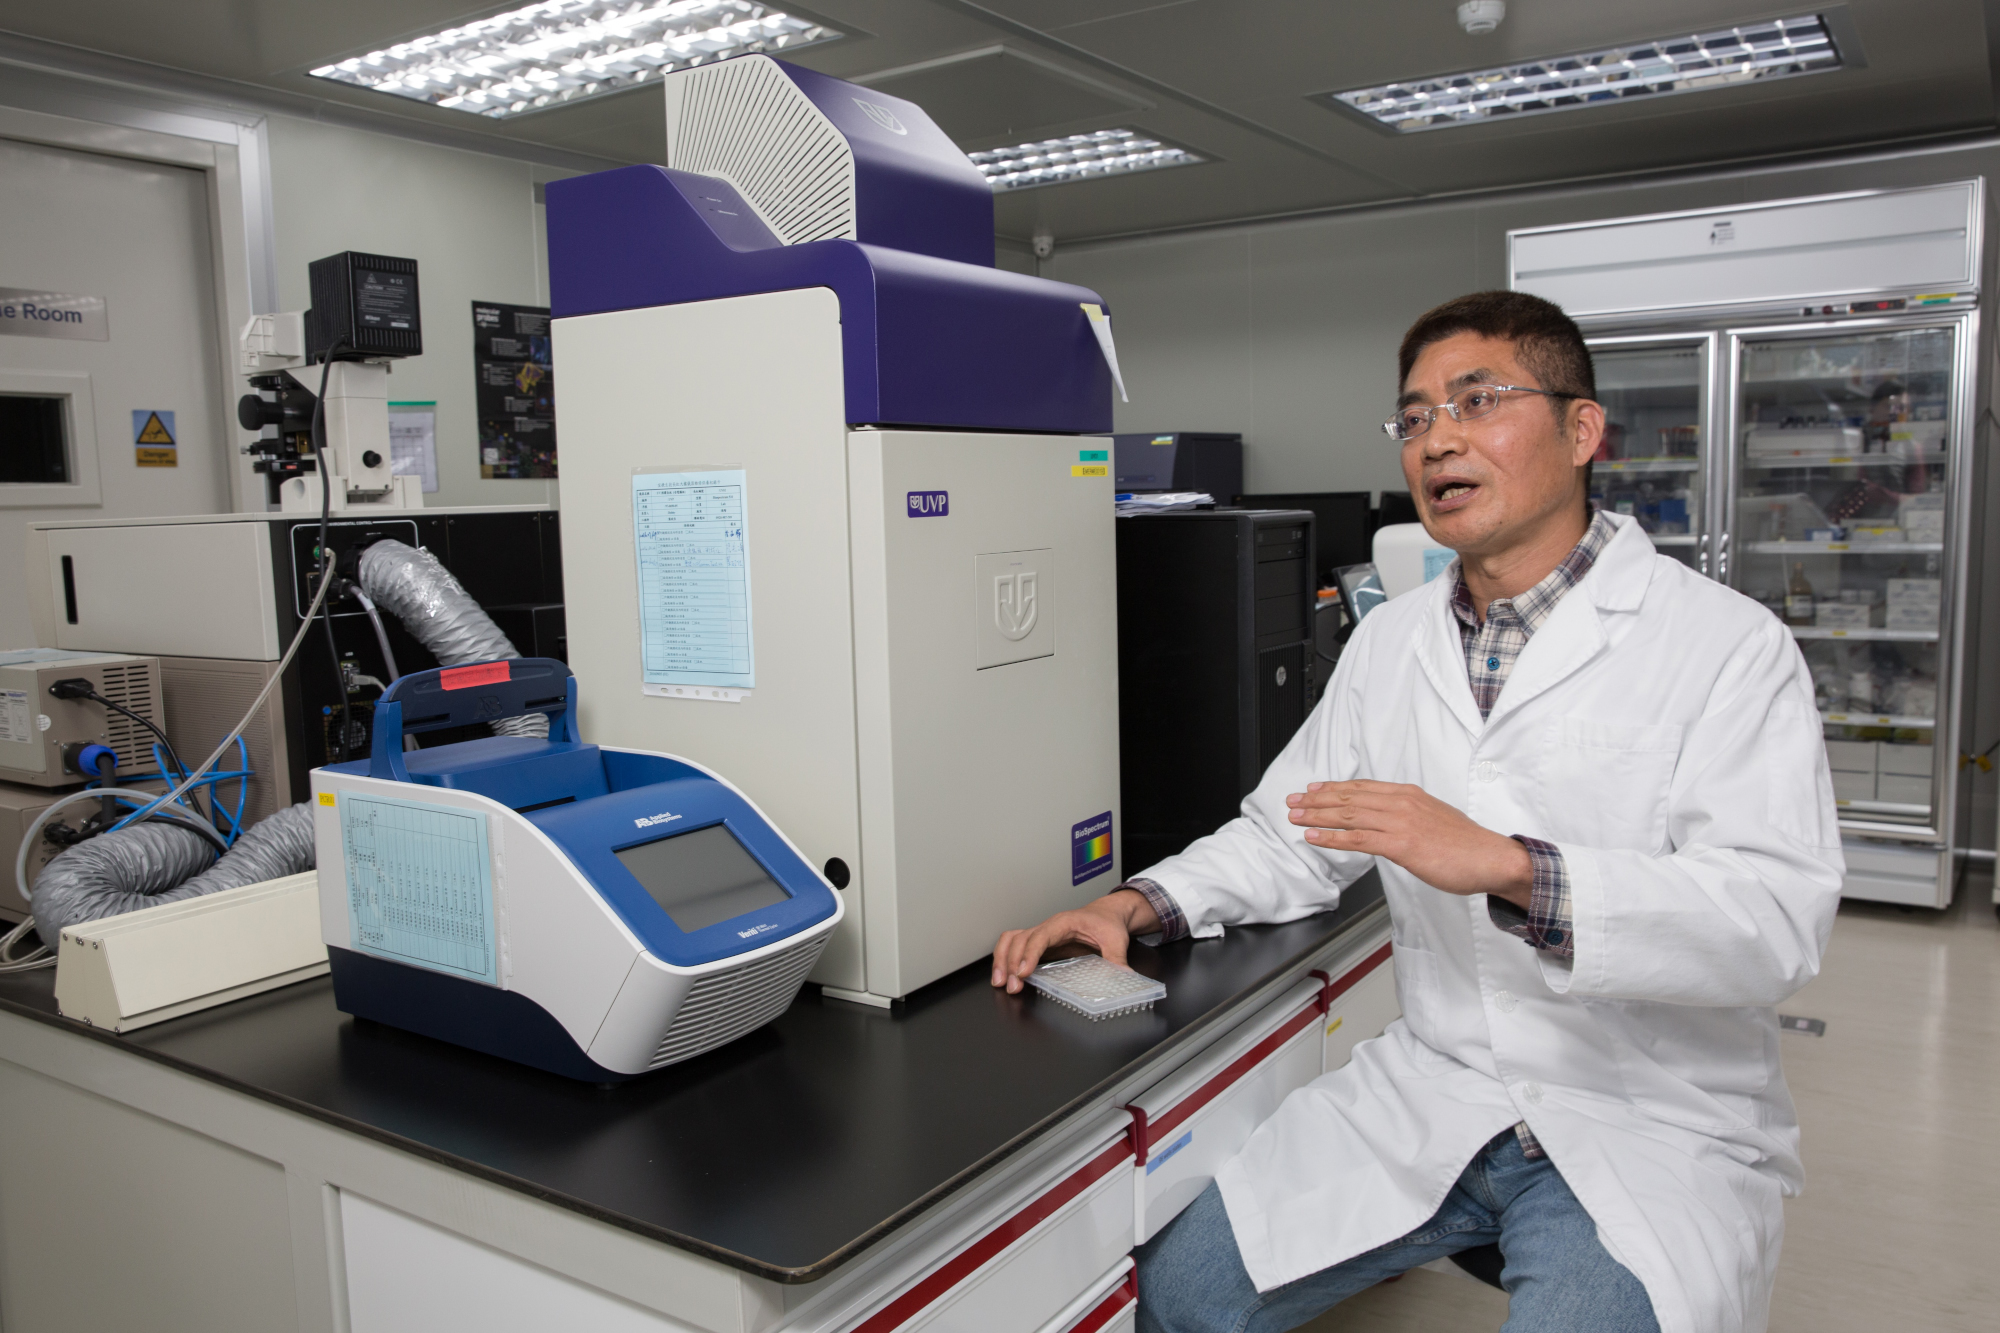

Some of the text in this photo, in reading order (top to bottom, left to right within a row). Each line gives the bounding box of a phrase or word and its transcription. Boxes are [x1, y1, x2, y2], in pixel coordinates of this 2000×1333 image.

[0, 302, 83, 324] e Room
[920, 494, 947, 513] UVP
[1075, 819, 1110, 840] BioSpectrum
